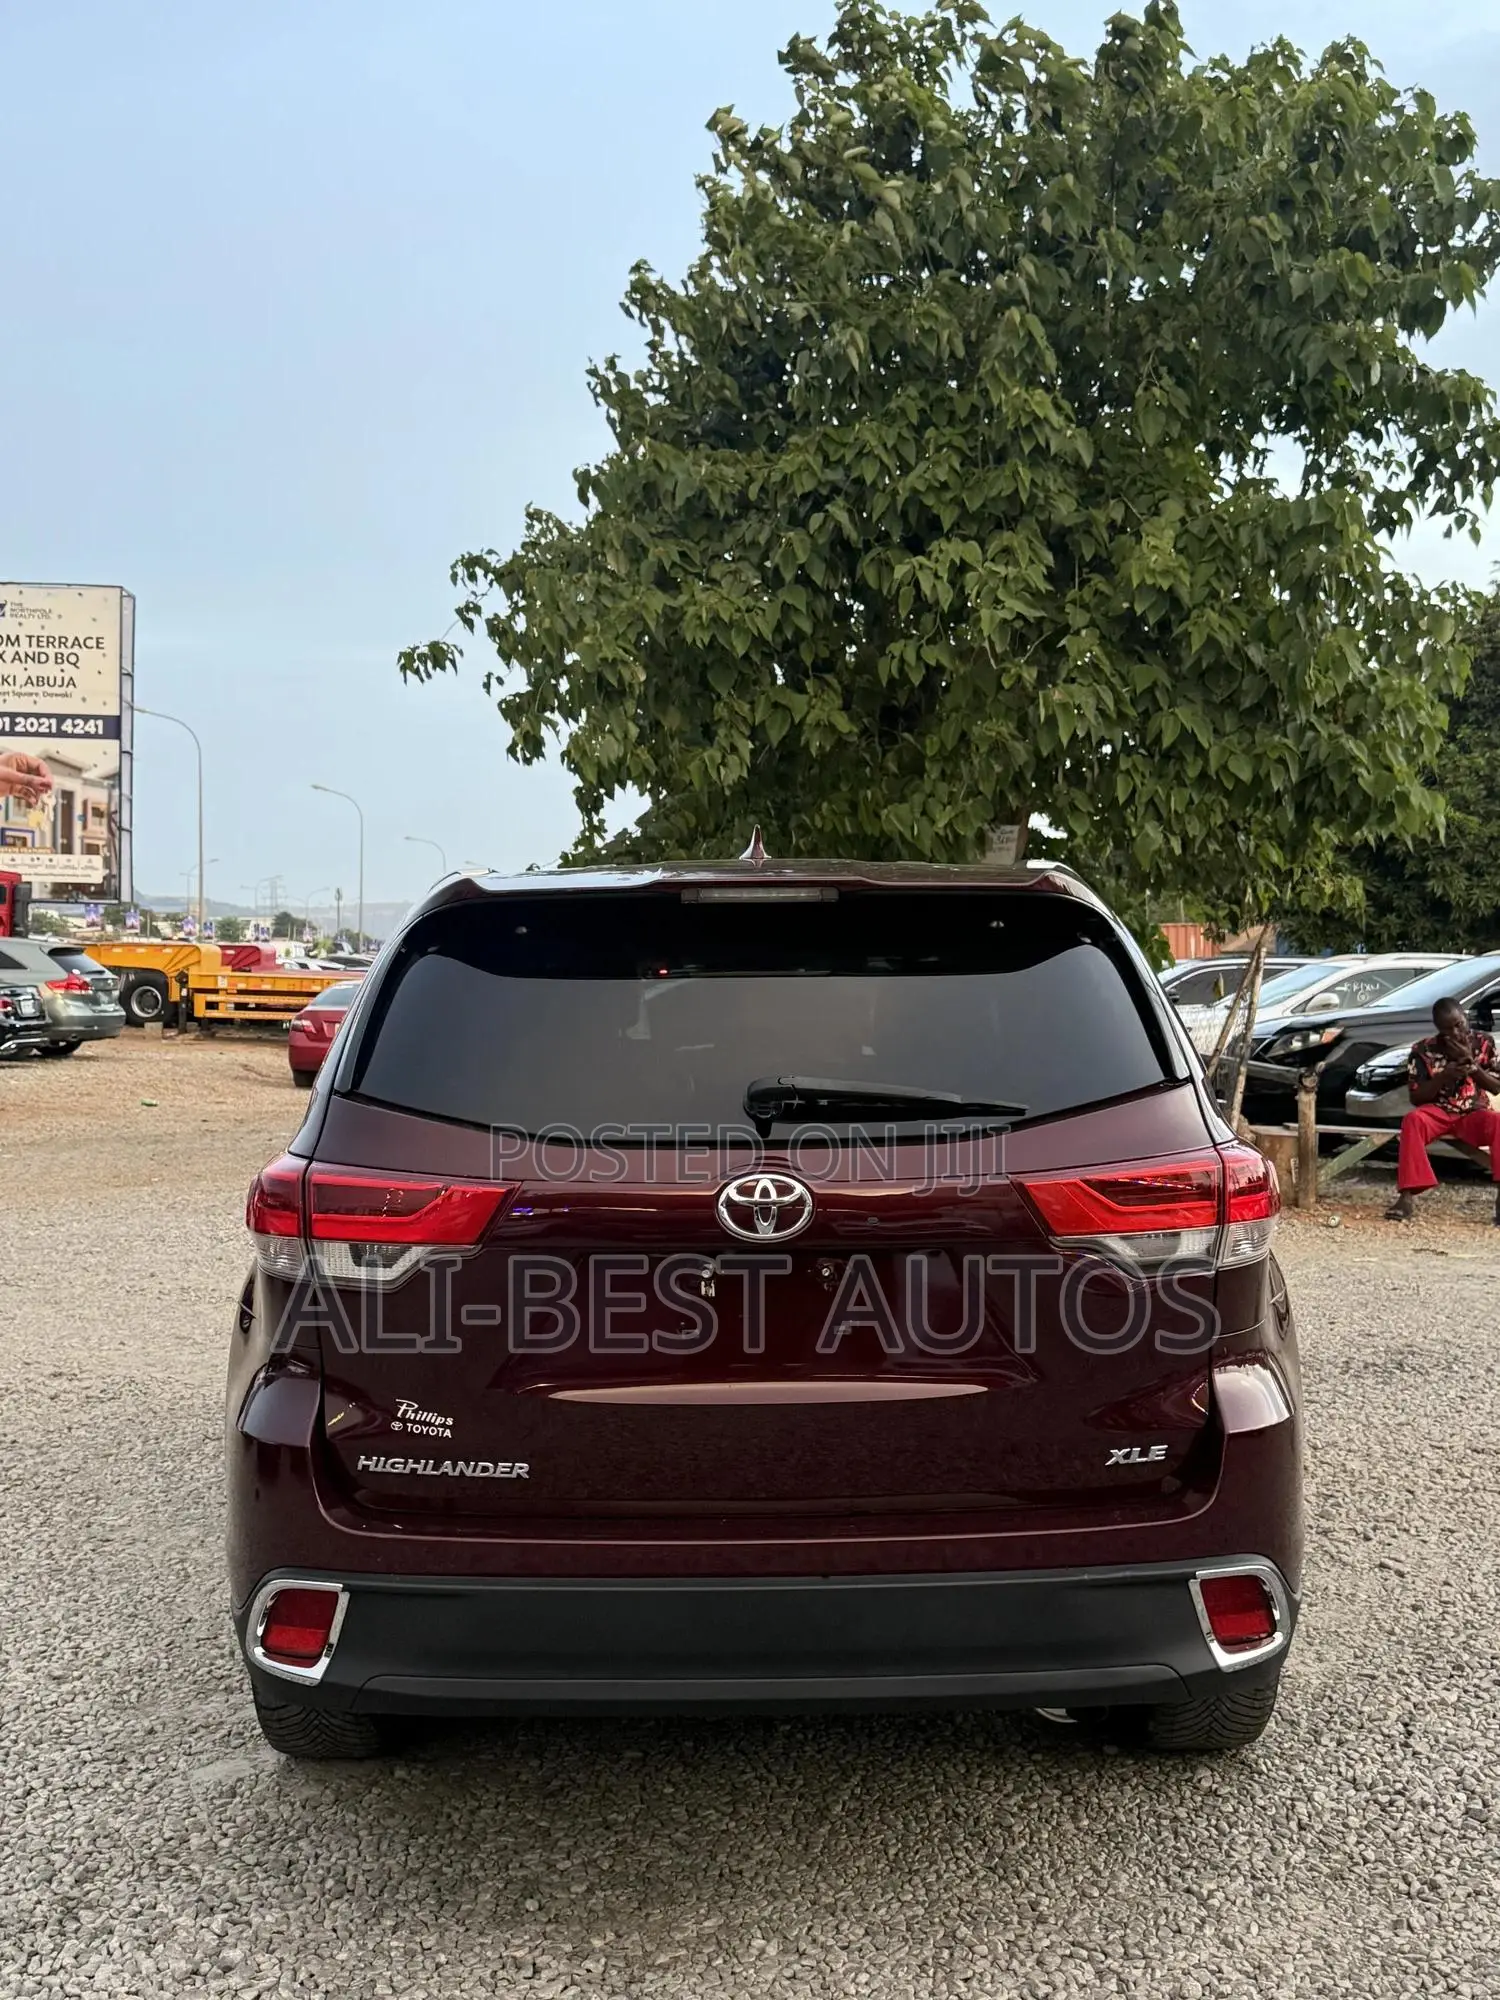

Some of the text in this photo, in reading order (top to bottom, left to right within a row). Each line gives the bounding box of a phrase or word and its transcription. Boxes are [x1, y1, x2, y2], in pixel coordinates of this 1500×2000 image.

[25, 634, 105, 650] TERRACE
[10, 650, 50, 664] AND
[54, 652, 80, 670] BQ
[0, 674, 17, 687] KI
[14, 716, 57, 733] 2021
[61, 718, 104, 735] 4241
[396, 1398, 454, 1426] Phillips
[406, 1423, 453, 1438] TOYOTA
[1105, 1444, 1169, 1466] XLE
[357, 1456, 530, 1479] HIGHLANDER
